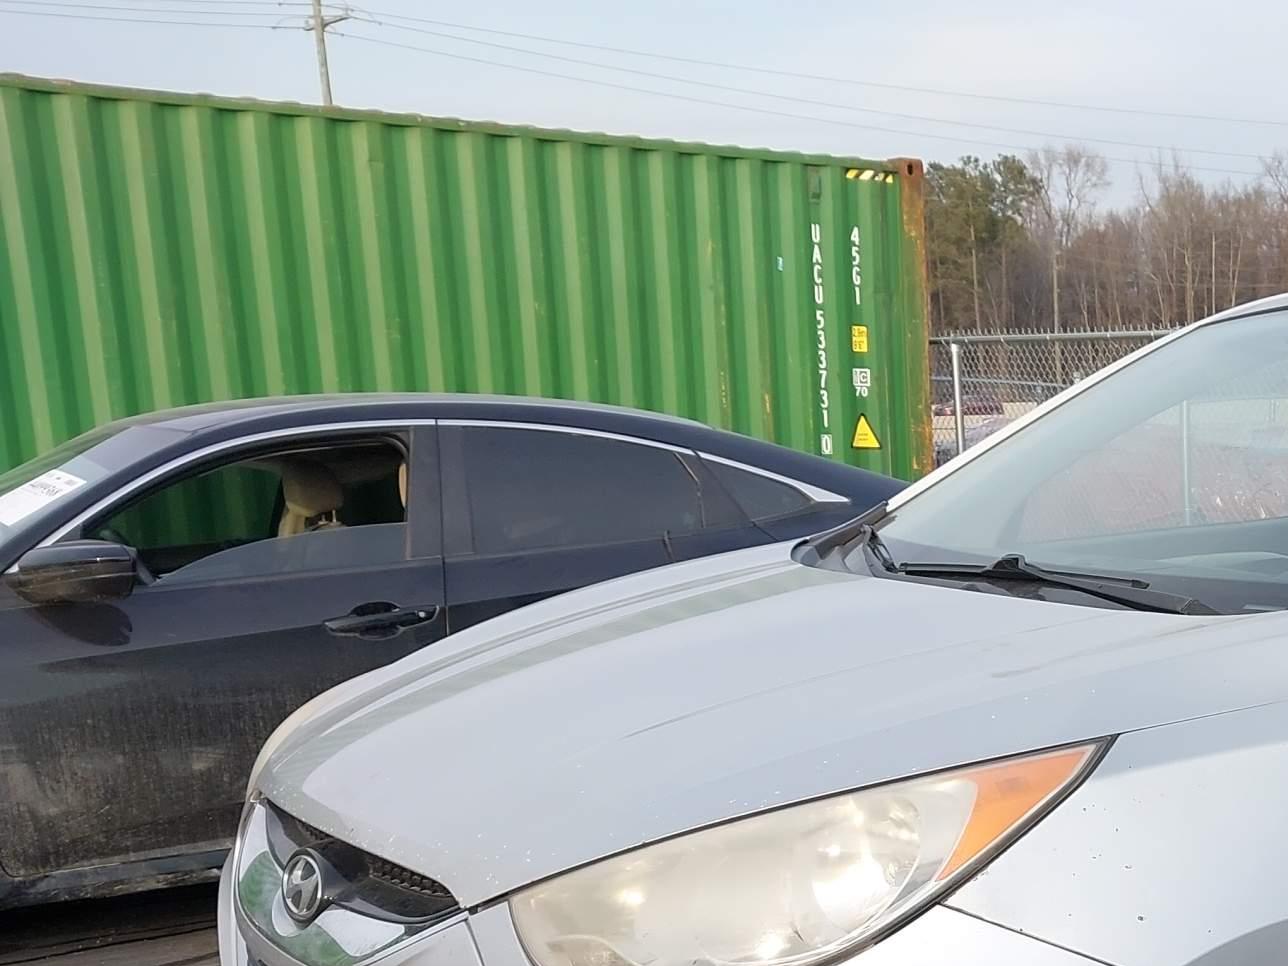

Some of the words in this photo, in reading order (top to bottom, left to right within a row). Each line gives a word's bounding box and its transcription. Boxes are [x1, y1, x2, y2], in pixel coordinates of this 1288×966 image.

[811, 223, 824, 304] UACU
[816, 309, 829, 428] 533731
[855, 386, 869, 397] 70
